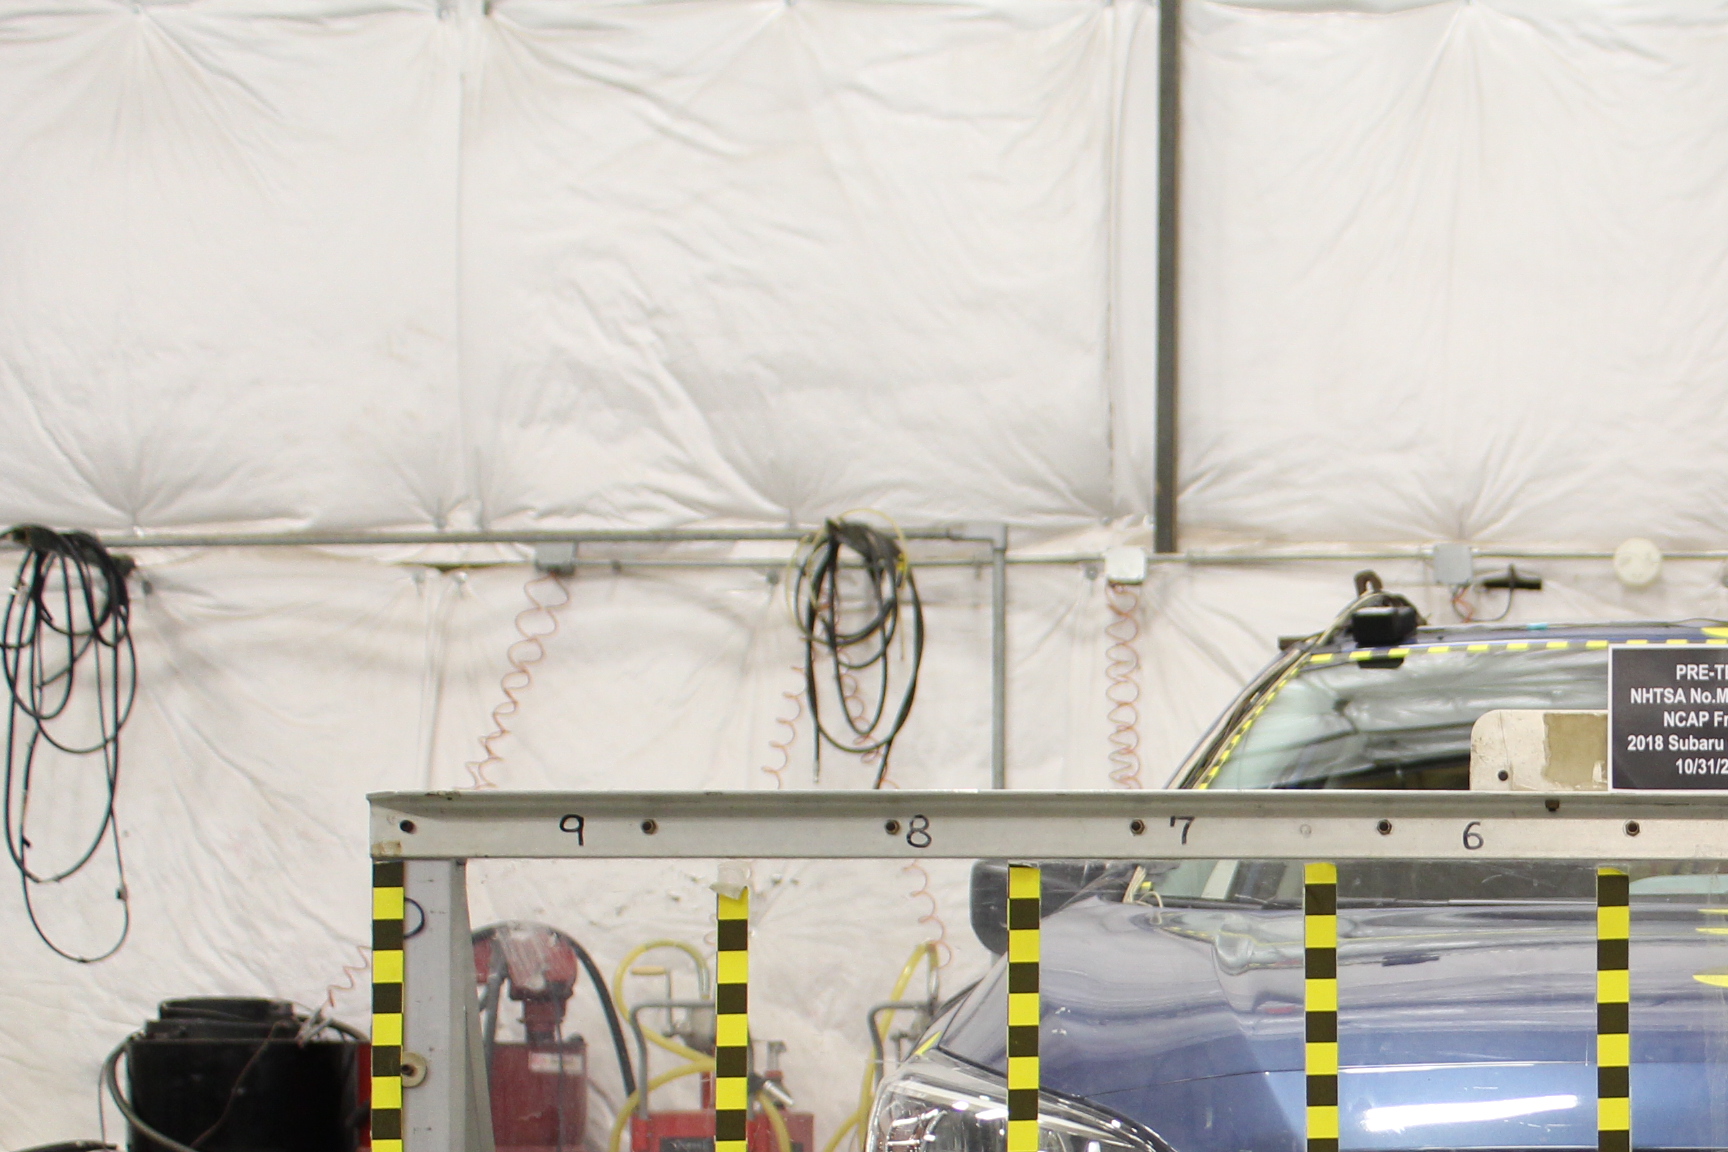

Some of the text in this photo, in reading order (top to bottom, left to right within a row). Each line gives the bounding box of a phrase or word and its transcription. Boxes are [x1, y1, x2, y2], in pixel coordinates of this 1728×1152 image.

[1630, 687, 1687, 705] NHTSA
[1663, 710, 1710, 728] NCAP
[1627, 734, 1664, 751] 2018
[1668, 734, 1724, 751] Subaru
[559, 813, 585, 847] 9
[906, 814, 933, 849] 8
[1169, 816, 1196, 846] 7
[1462, 821, 1484, 851] 6
